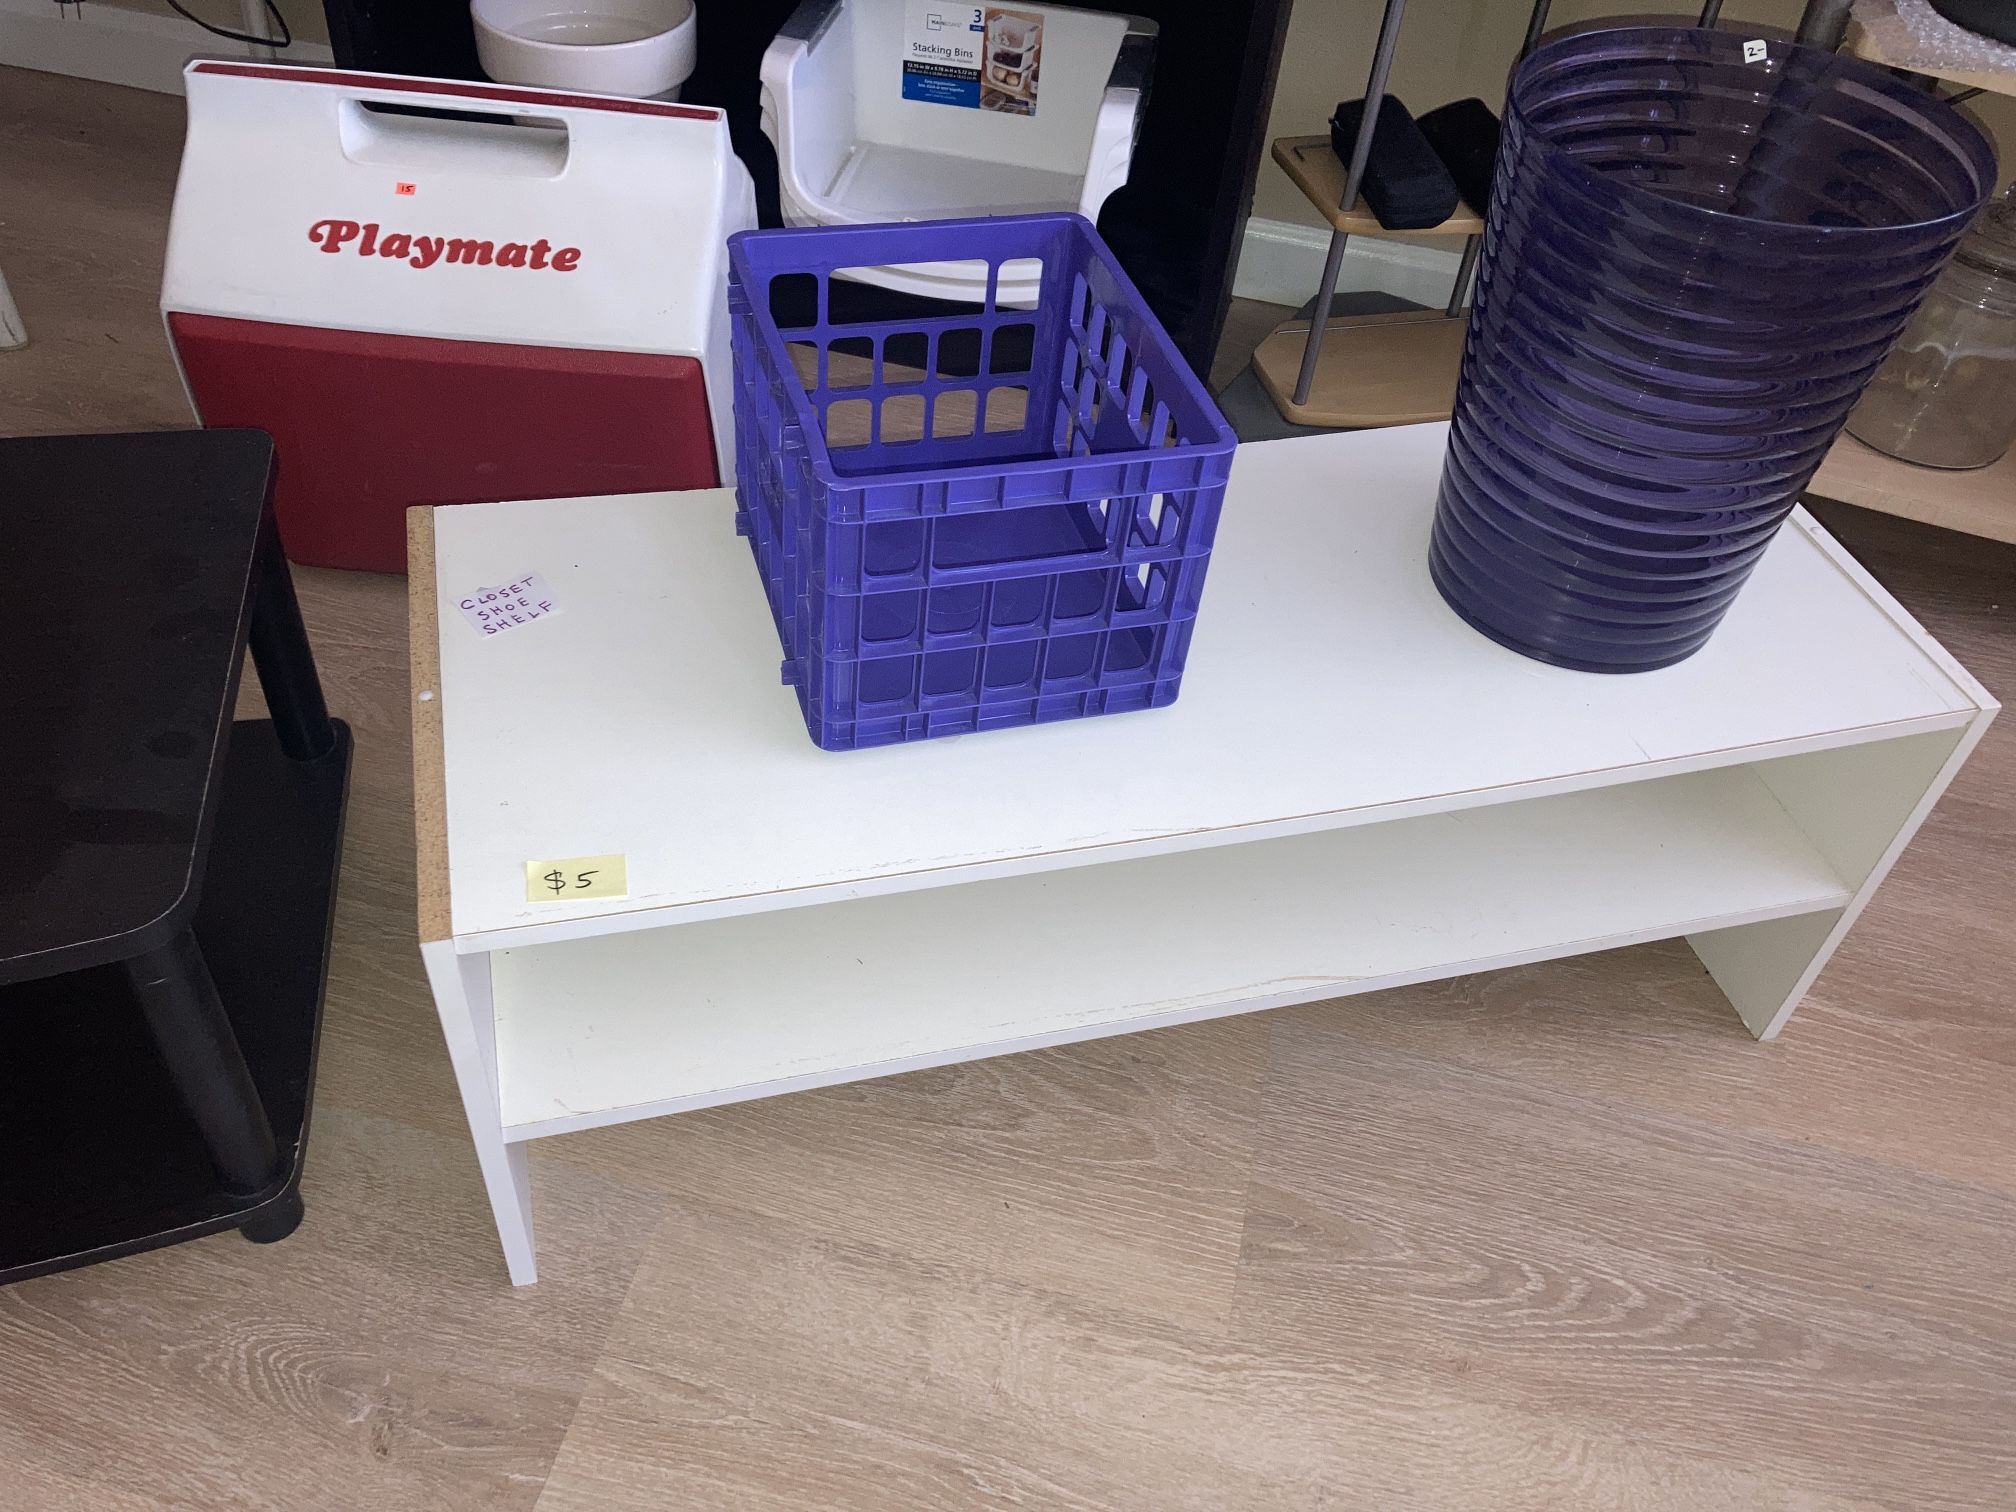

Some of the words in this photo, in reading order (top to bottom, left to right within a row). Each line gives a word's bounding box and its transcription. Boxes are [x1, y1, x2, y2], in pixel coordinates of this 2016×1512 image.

[973, 9, 983, 23] 3
[912, 42, 952, 58] Stacking
[954, 48, 974, 59] Bins
[401, 184, 414, 193] 15
[308, 219, 582, 272] Playmate
[460, 576, 533, 610] CLOSET
[477, 597, 530, 621] SHOE
[483, 600, 552, 634] SHELF
